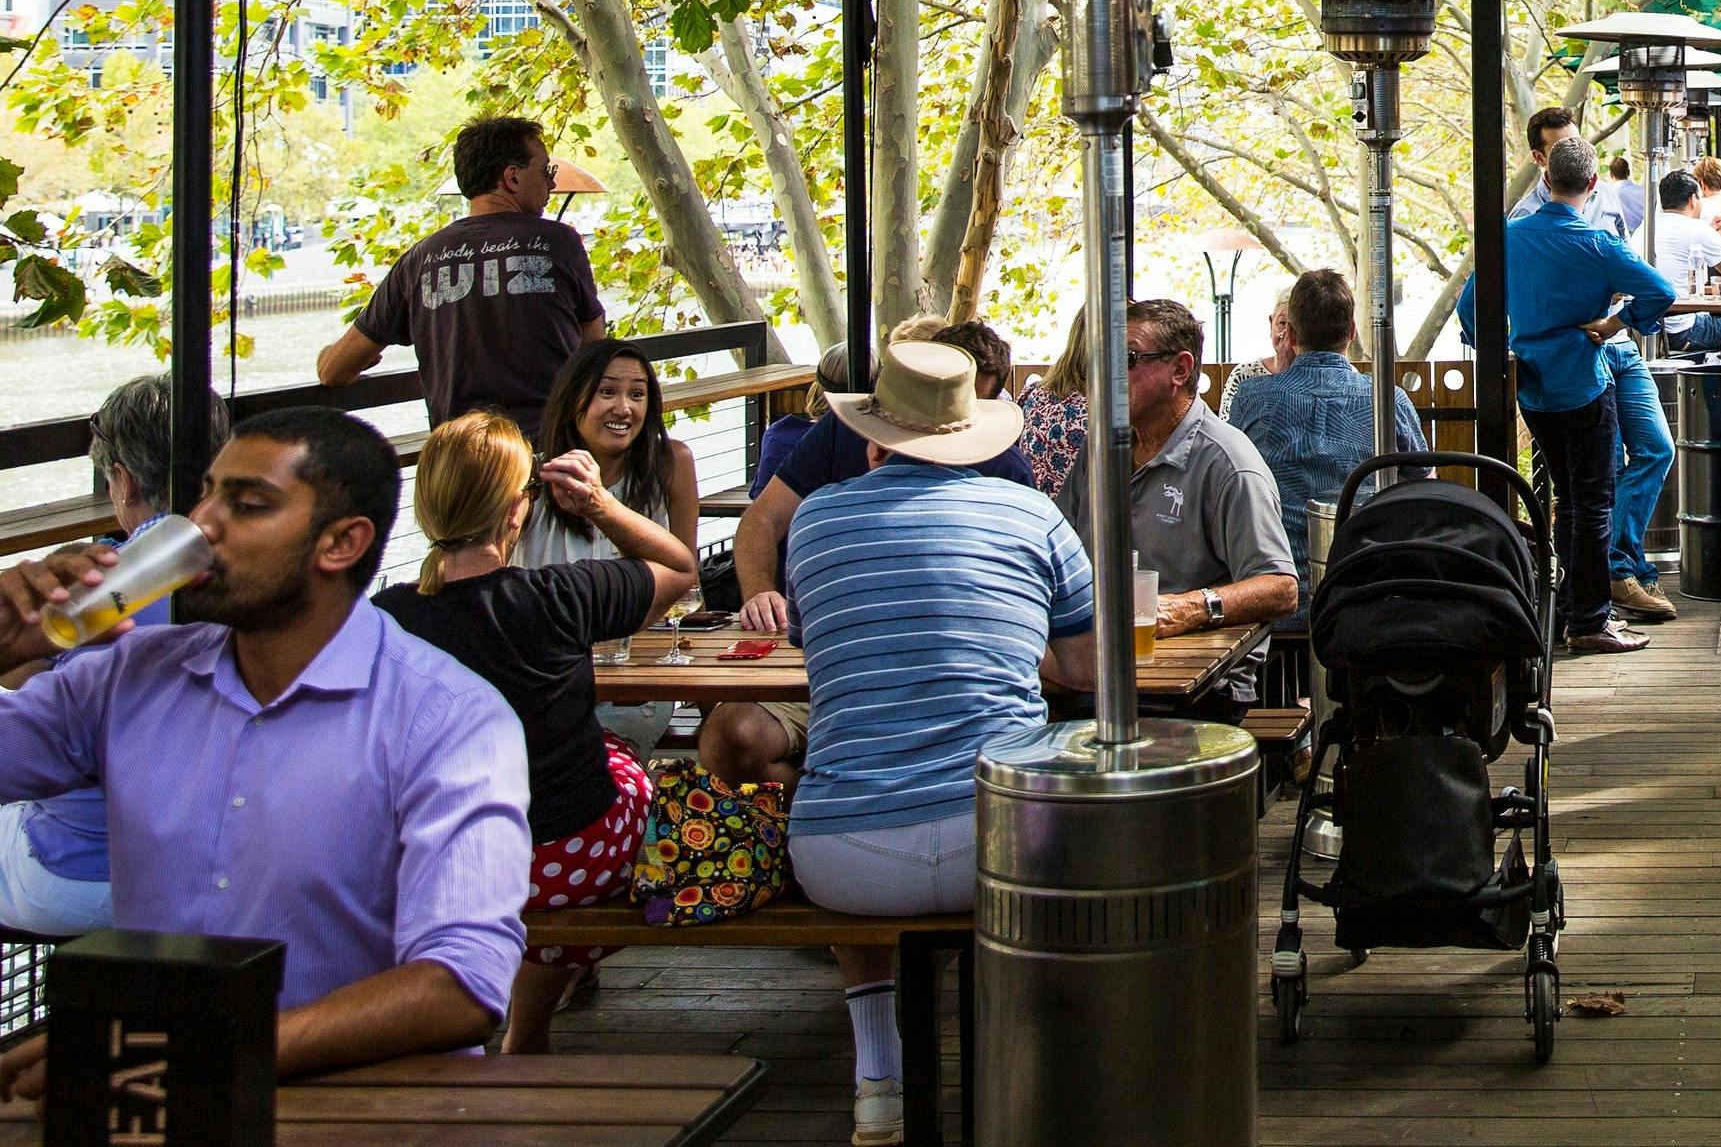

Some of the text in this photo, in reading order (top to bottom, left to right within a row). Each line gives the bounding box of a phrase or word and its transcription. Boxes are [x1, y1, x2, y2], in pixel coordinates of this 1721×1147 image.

[423, 235, 553, 266] Nobody beats the
[421, 255, 556, 310] WIZ
[106, 1017, 169, 1147] EAT
